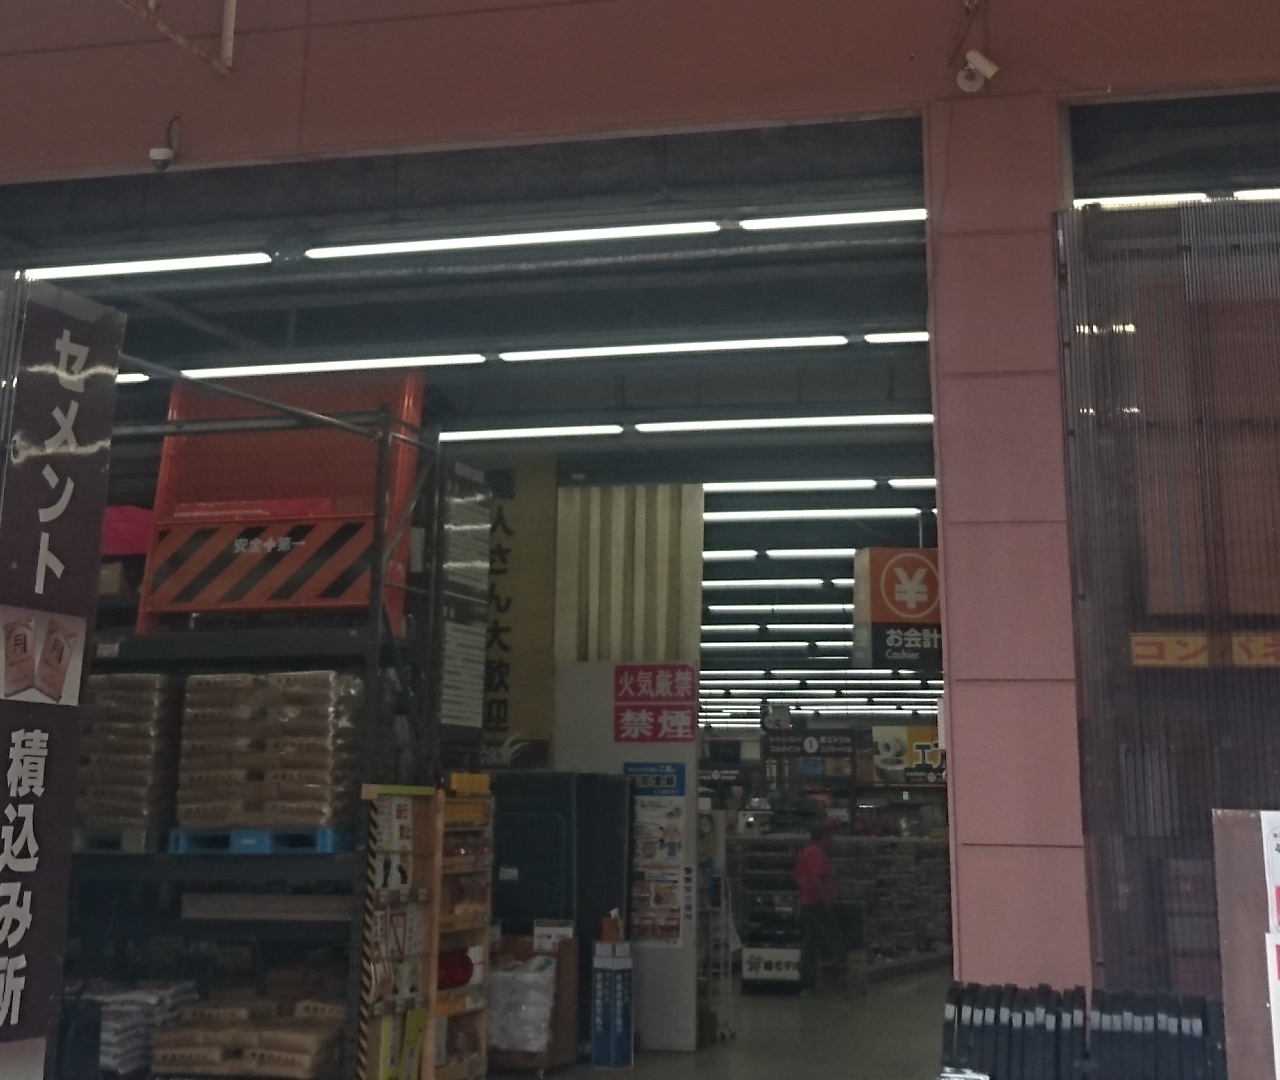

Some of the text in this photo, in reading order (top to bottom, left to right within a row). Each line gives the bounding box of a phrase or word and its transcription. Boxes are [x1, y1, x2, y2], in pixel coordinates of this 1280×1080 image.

[33, 329, 91, 595] セメント
[886, 627, 940, 648] お会計
[886, 649, 920, 659] Cashier
[618, 669, 692, 698] 火気厳禁
[619, 709, 694, 738] 禁煙
